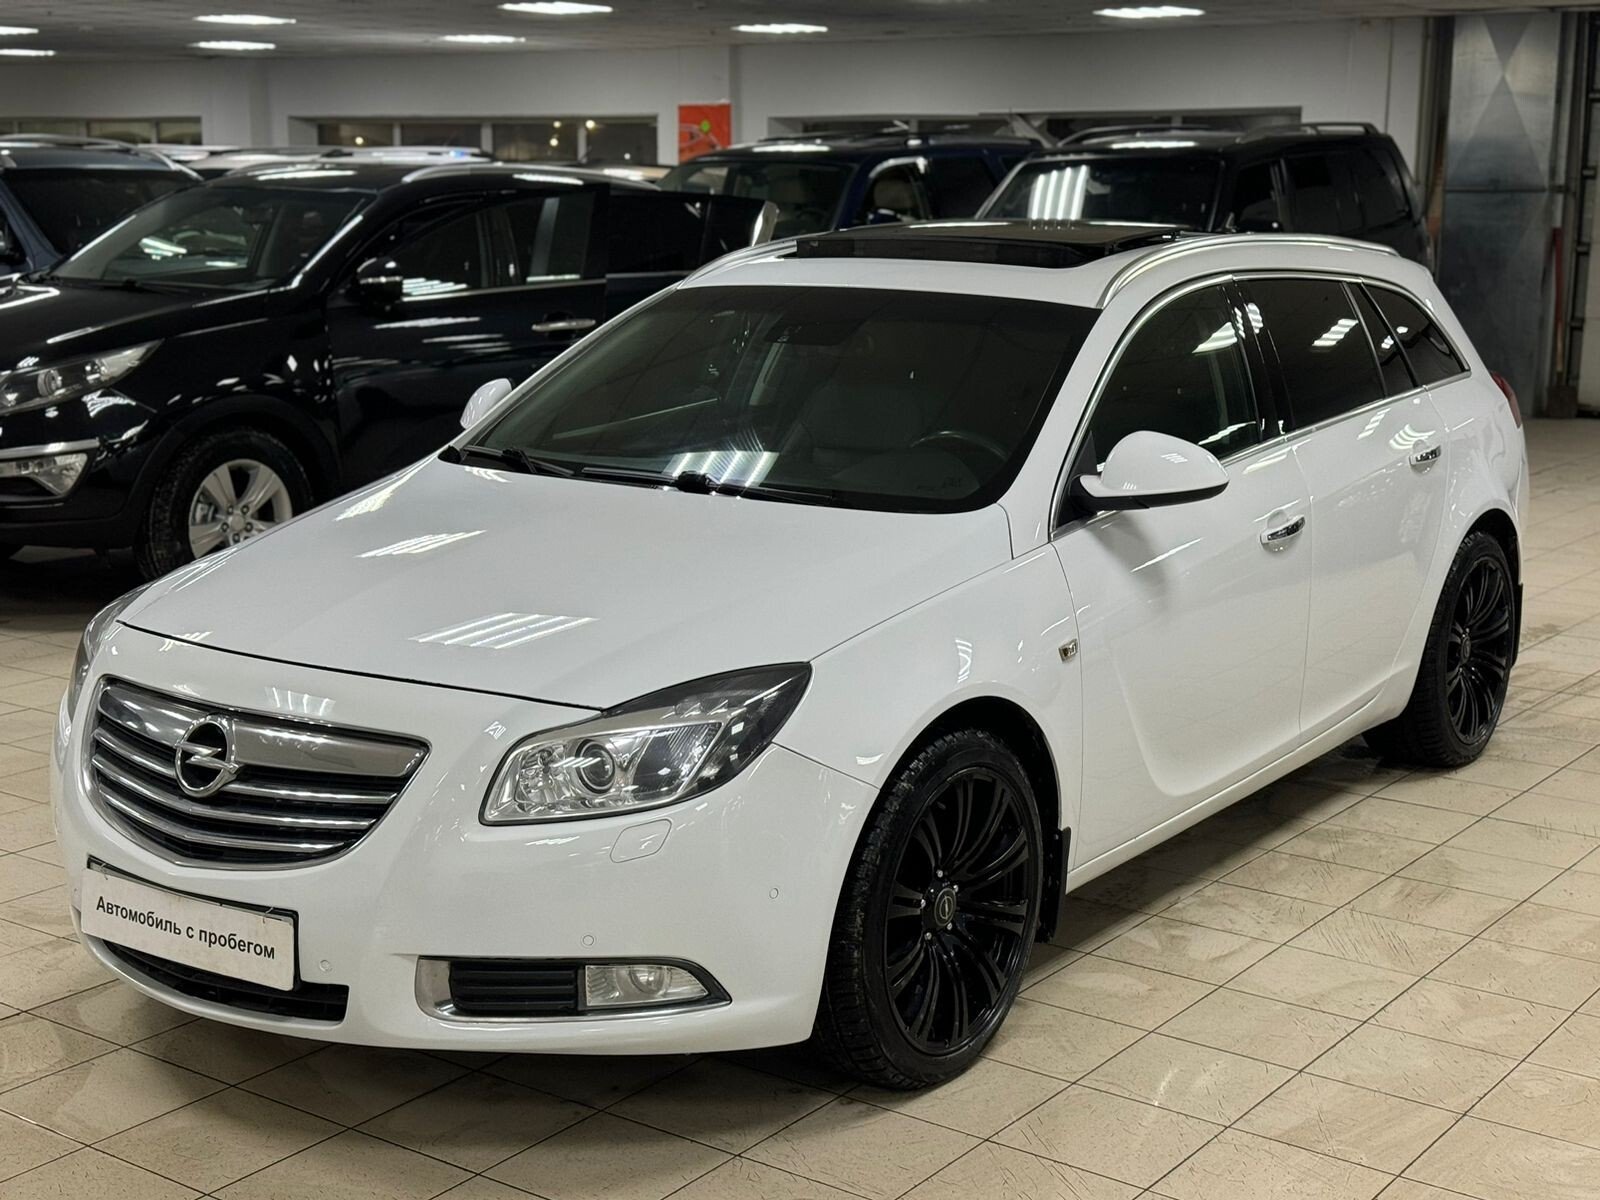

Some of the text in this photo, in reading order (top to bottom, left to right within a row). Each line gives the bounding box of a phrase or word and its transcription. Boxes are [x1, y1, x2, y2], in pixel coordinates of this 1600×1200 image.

[96, 896, 275, 959] Автомобиль с пробегом
